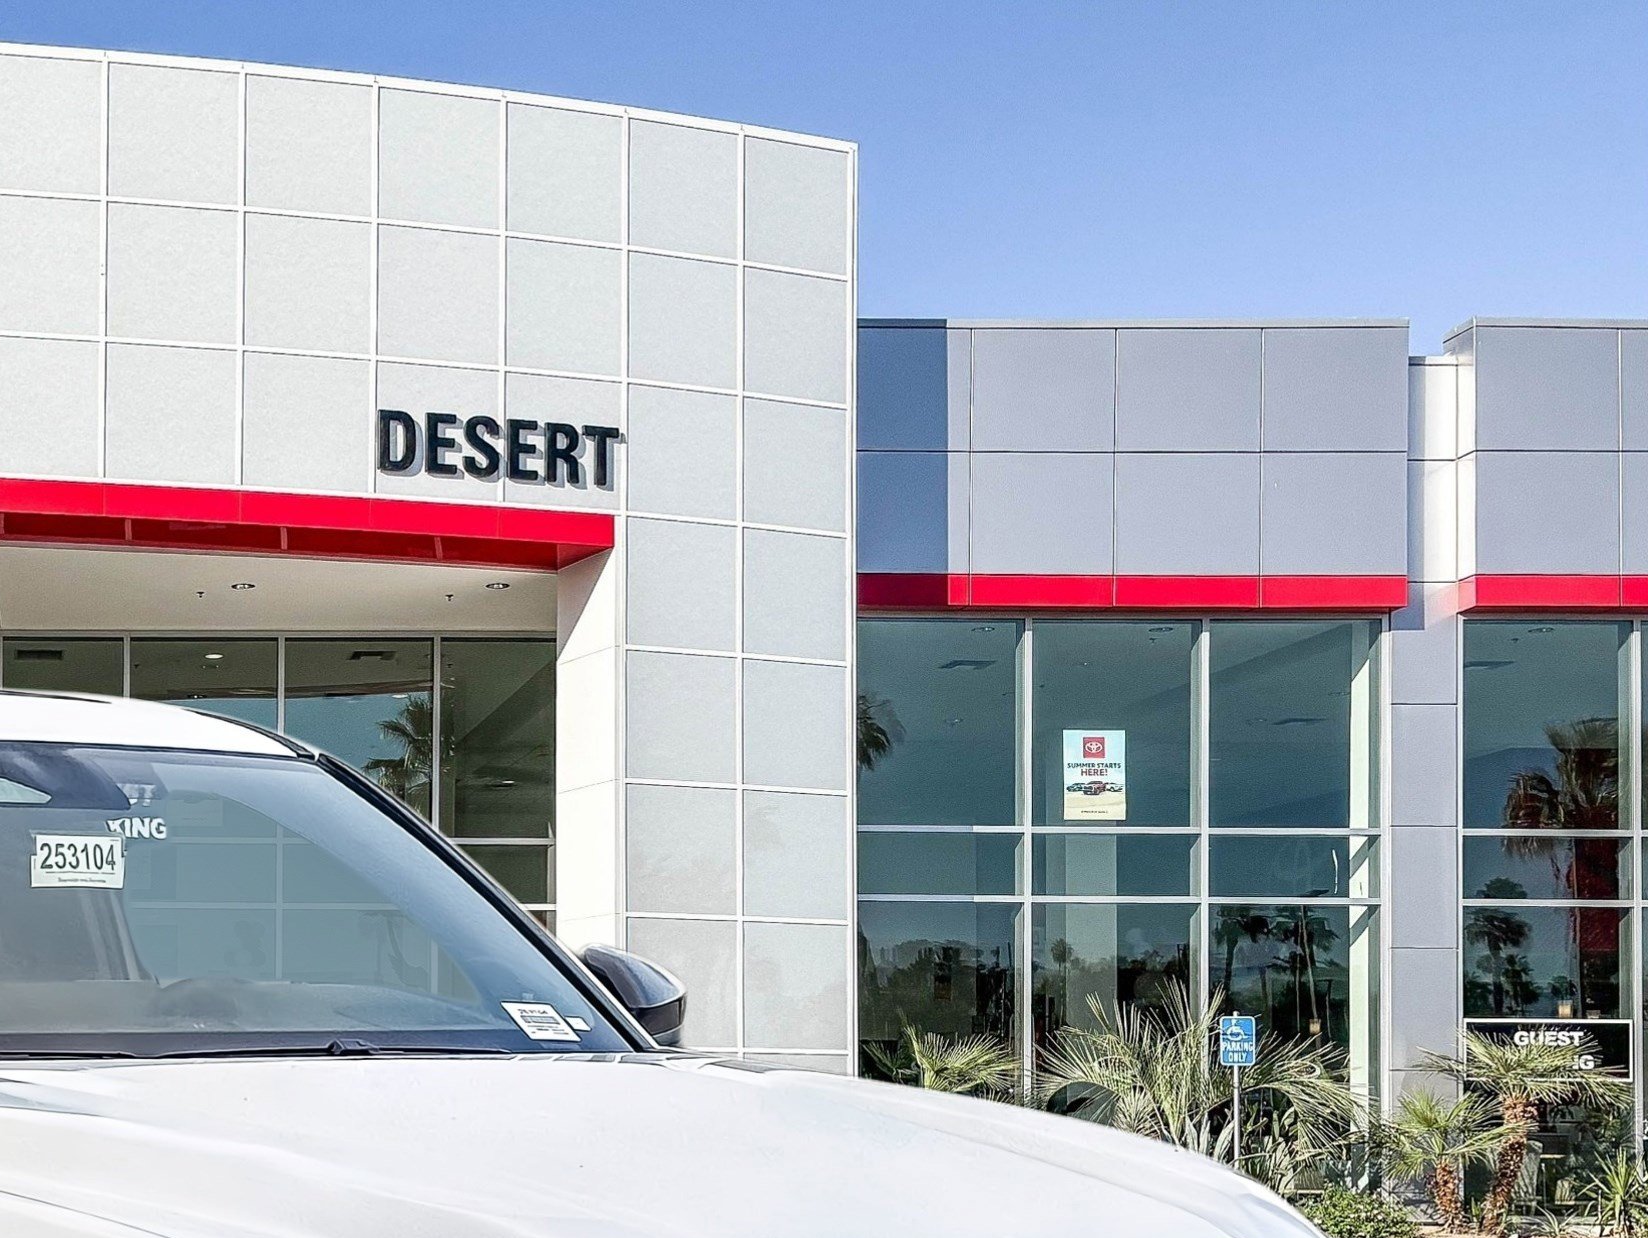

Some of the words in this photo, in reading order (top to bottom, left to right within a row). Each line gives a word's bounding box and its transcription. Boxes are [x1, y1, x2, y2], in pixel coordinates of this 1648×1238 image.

[376, 409, 620, 486] DESERT
[1081, 768, 1108, 776] HERE!
[39, 843, 116, 870] 253104
[1513, 1031, 1584, 1046] GUEST
[1222, 1041, 1254, 1051] PARKING
[1228, 1052, 1247, 1062] ONLY
